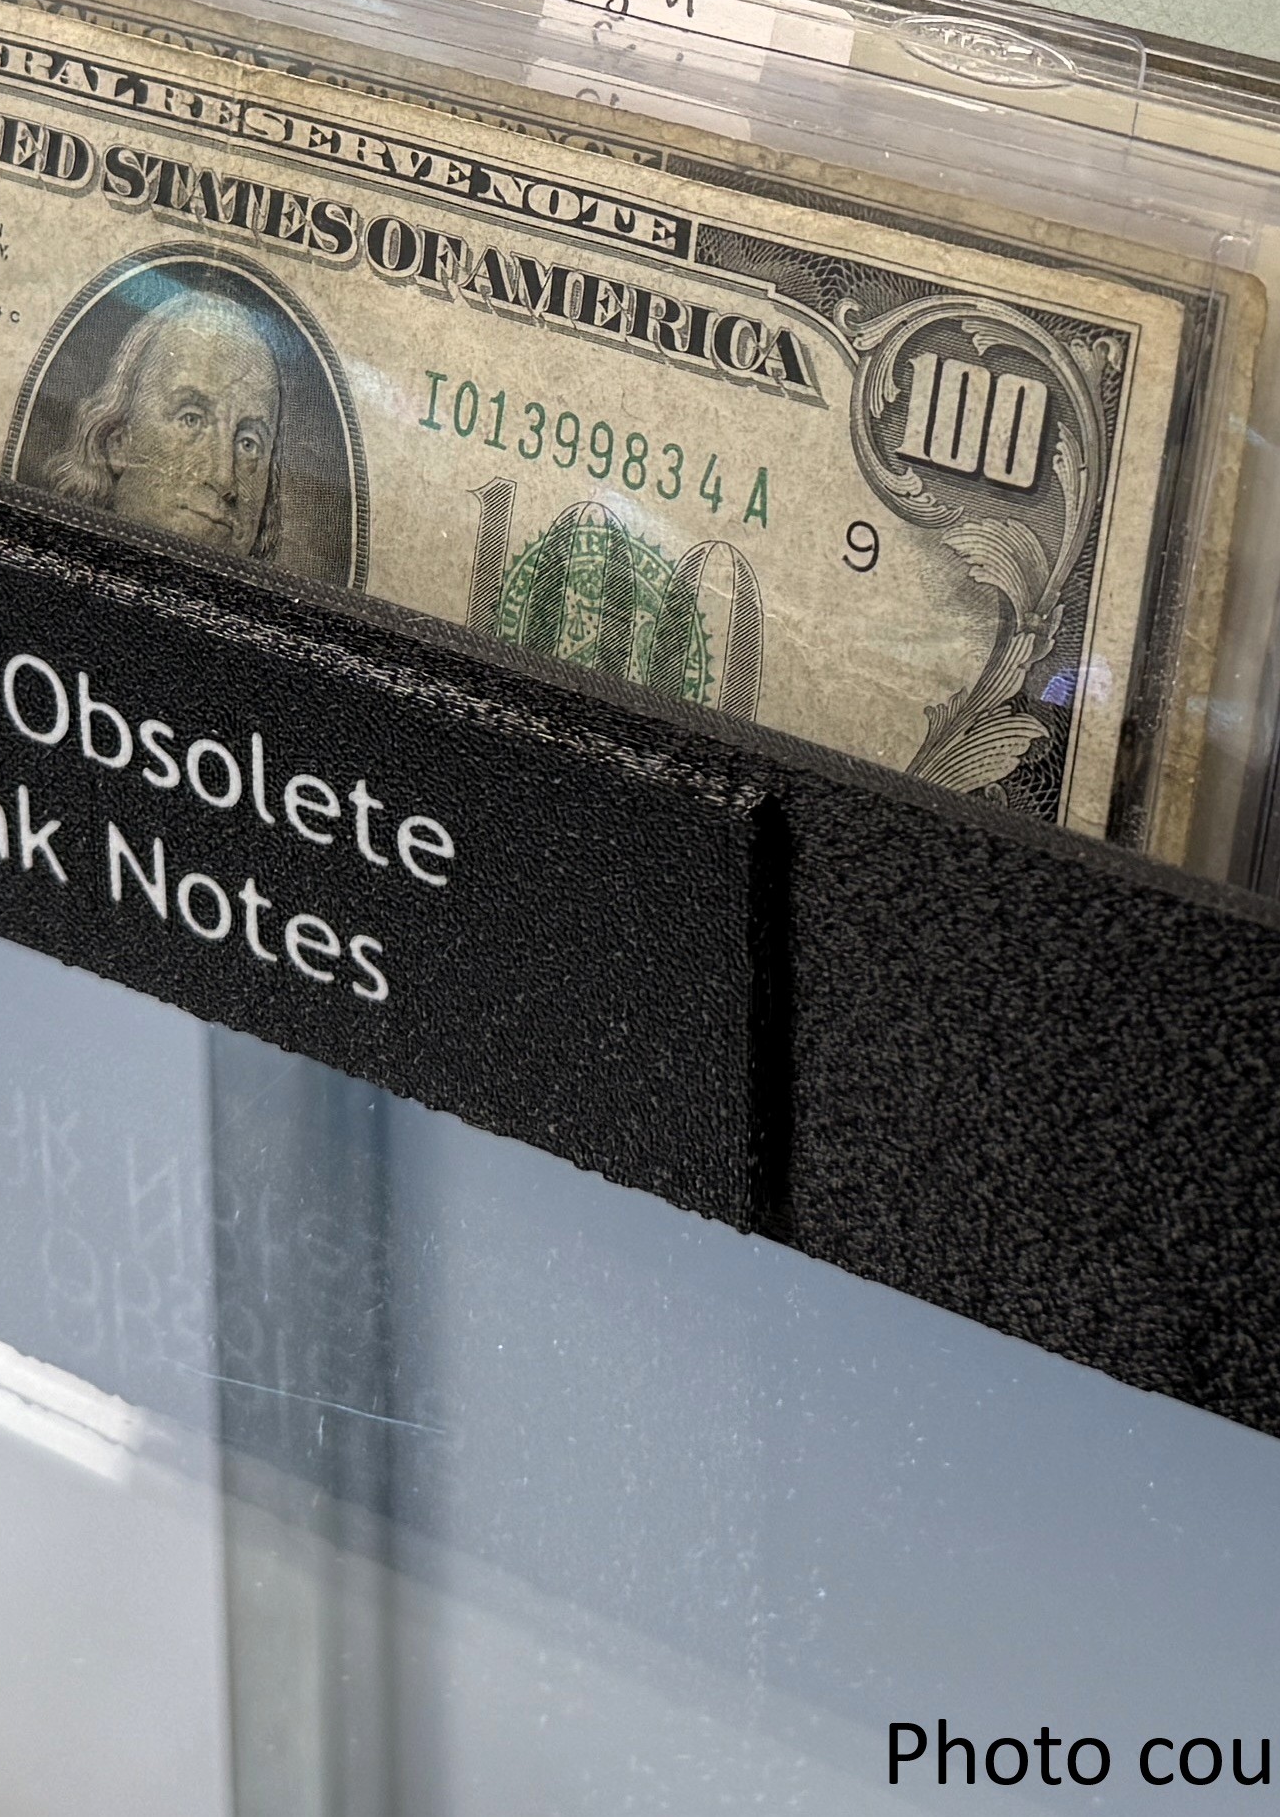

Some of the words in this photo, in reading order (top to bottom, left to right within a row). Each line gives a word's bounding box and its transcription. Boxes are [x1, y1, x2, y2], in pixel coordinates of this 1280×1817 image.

[138, 85, 477, 197] RESERVE
[485, 171, 679, 251] NOTE
[9, 309, 21, 324] C
[101, 143, 366, 277] STATES
[366, 213, 467, 301] OF
[465, 247, 829, 409] AMERICA
[896, 351, 1049, 491] 100
[841, 519, 881, 574] 9
[3, 653, 456, 886] Obsolete
[108, 820, 390, 1002] Notes
